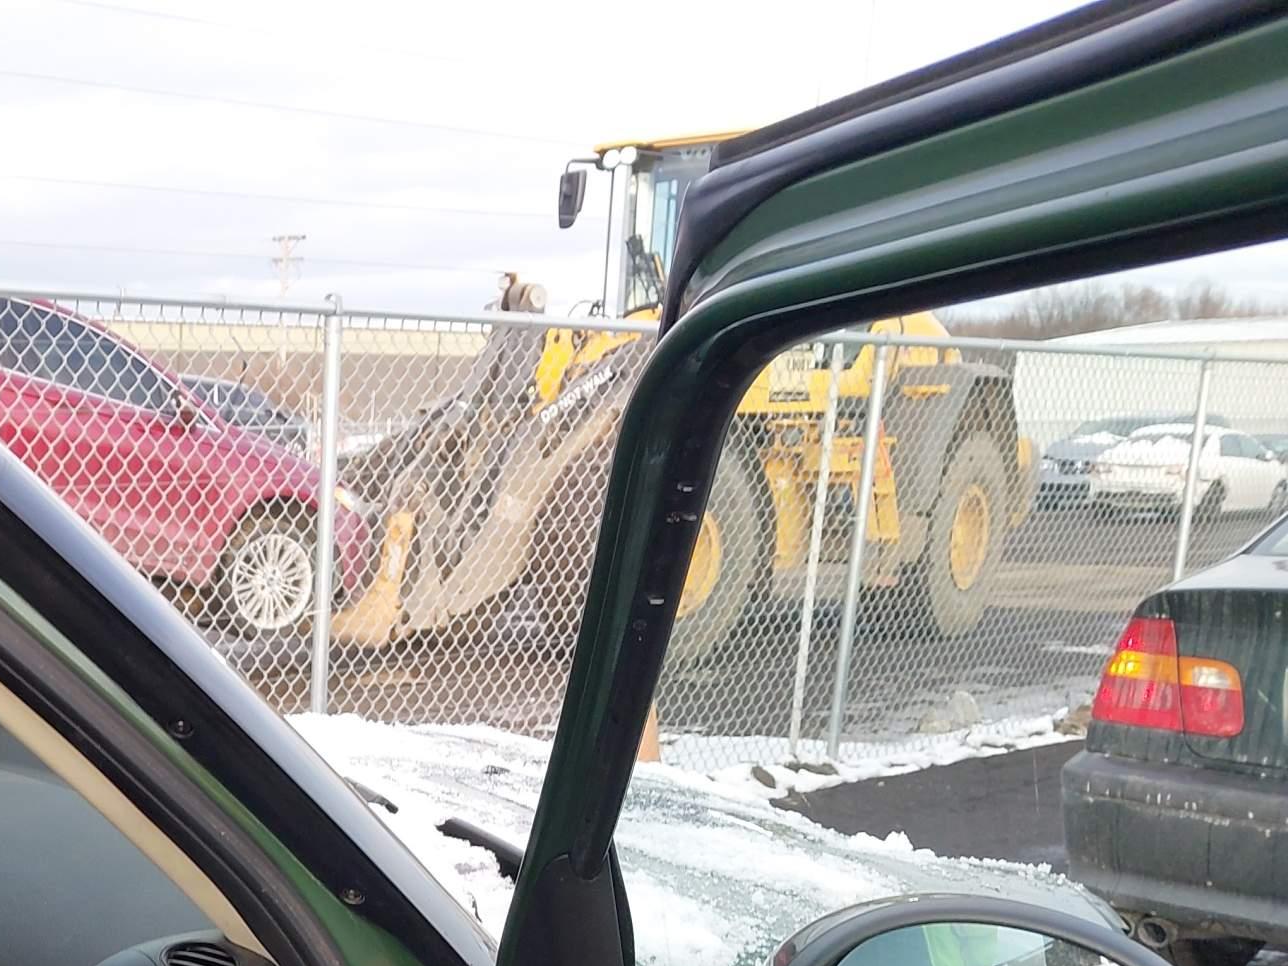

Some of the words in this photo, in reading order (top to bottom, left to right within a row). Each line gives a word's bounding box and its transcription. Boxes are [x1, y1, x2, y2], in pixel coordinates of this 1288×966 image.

[541, 404, 558, 424] DO
[558, 386, 582, 411] NOT
[582, 365, 612, 393] WALK
